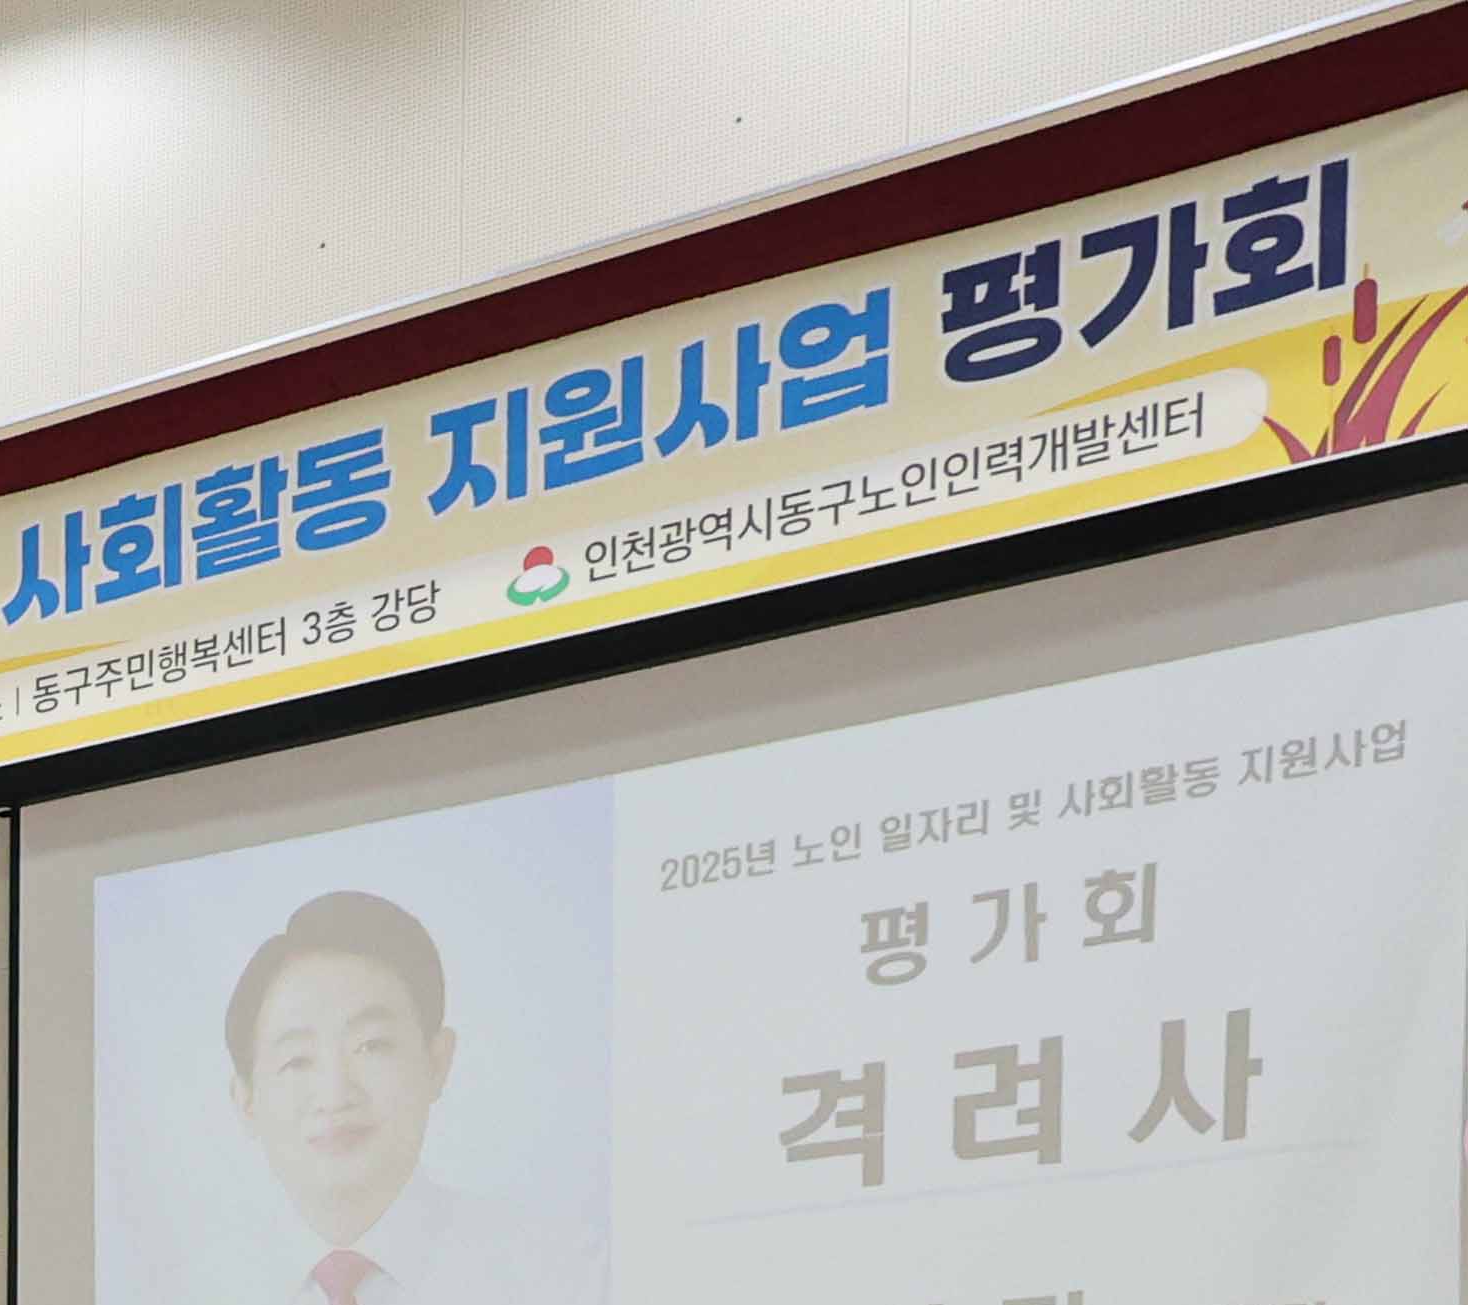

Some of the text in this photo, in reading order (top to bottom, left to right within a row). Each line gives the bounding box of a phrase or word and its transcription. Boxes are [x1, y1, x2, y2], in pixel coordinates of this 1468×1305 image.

[2, 425, 390, 626] 사회활동
[427, 288, 891, 513] 지원사업
[941, 158, 1348, 382] 평가회
[584, 391, 1205, 583] 인천광역시동구노인인력개발센터
[33, 615, 287, 714] 동구주민행복센터
[302, 600, 356, 645] 3층
[370, 579, 441, 632] 강당
[660, 720, 1407, 893] 2025년 노인 일자리 및 사회활동 지원사업
